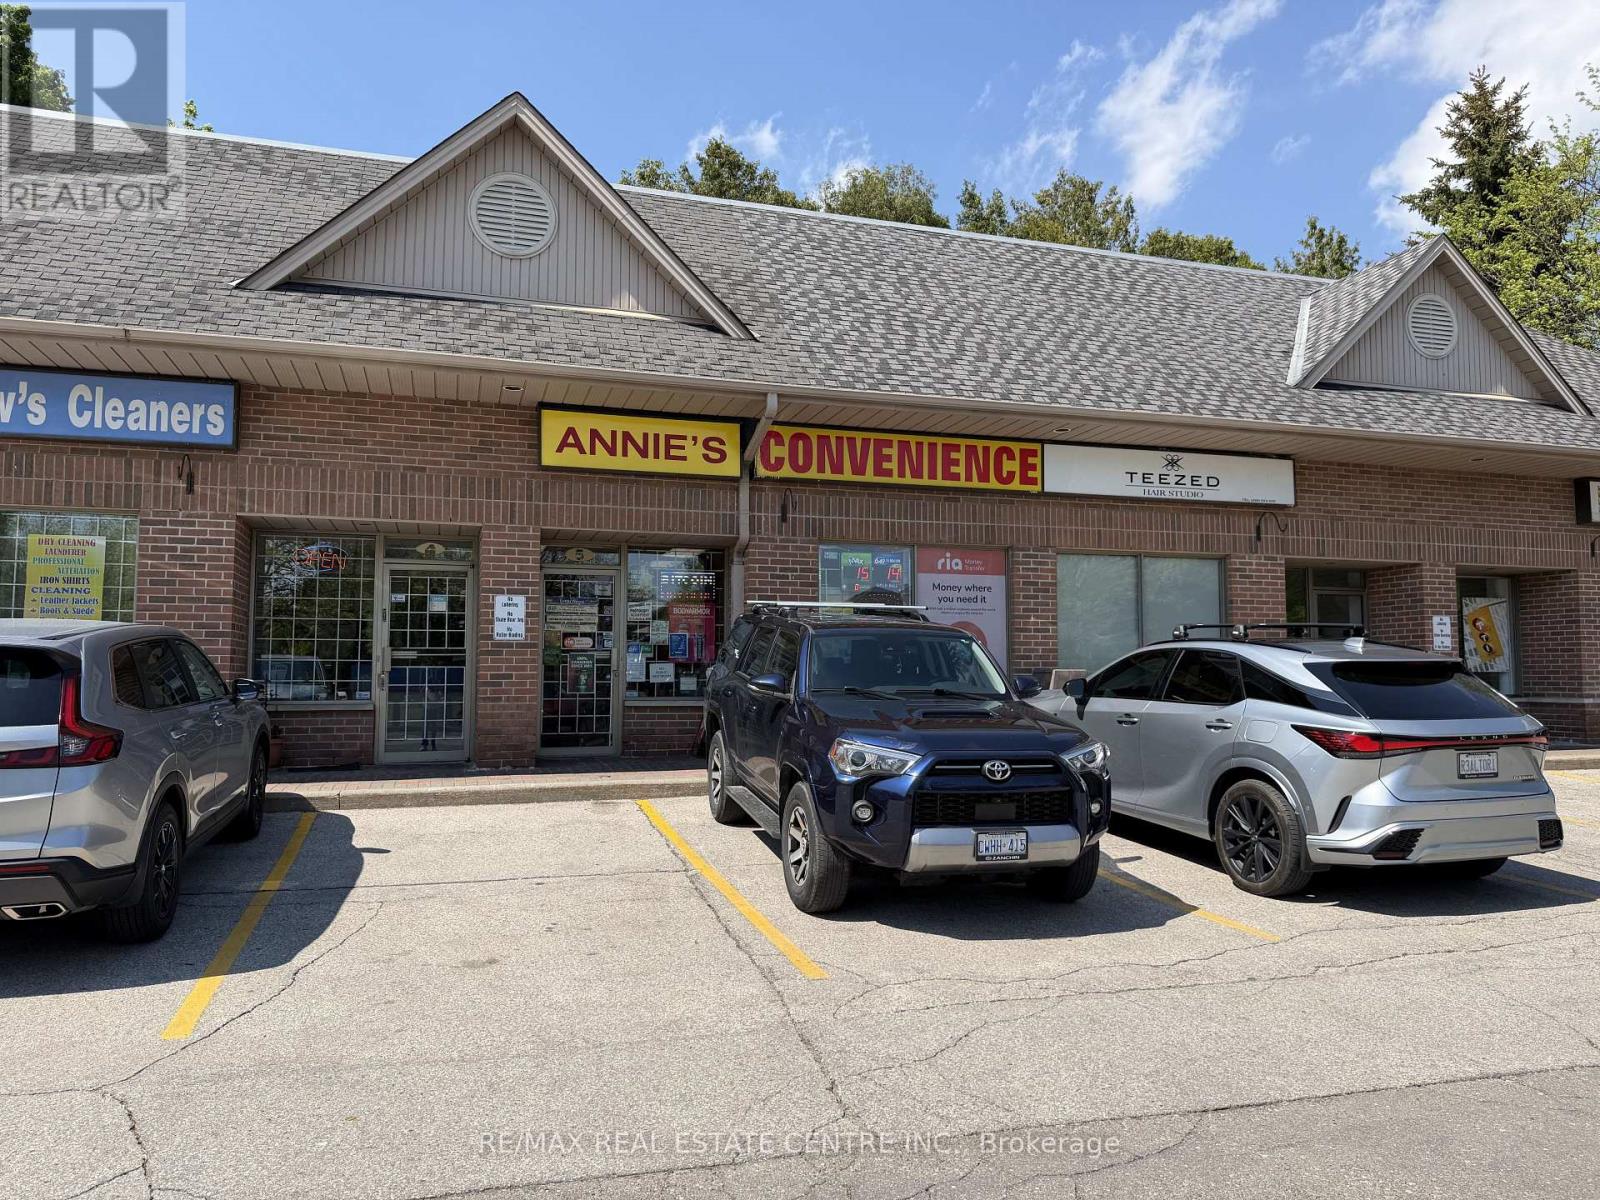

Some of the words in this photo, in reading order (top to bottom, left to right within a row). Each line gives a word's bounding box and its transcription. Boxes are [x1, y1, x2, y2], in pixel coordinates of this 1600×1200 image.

[67, 383, 225, 436] Cleaners
[555, 426, 728, 465] ANNIE'S
[759, 430, 1039, 486] CONVENIENCE
[1125, 472, 1220, 487] TEEZED
[1143, 488, 1166, 496] HAIR
[1168, 490, 1204, 499] STUDIO
[38, 537, 55, 546] DRY
[58, 538, 96, 547] CLEANING
[32, 557, 85, 565] PROFESSIONAL
[292, 548, 347, 570] OPEN
[937, 551, 963, 570] ria
[39, 576, 60, 584] IRON
[62, 576, 90, 585] SHIRTS
[932, 582, 962, 593] Money
[964, 584, 992, 593] where
[40, 596, 69, 604] Leather
[71, 597, 99, 605] Jackets
[937, 596, 954, 604] you
[956, 595, 978, 603] need
[980, 595, 987, 604] it
[39, 606, 61, 614] Boots
